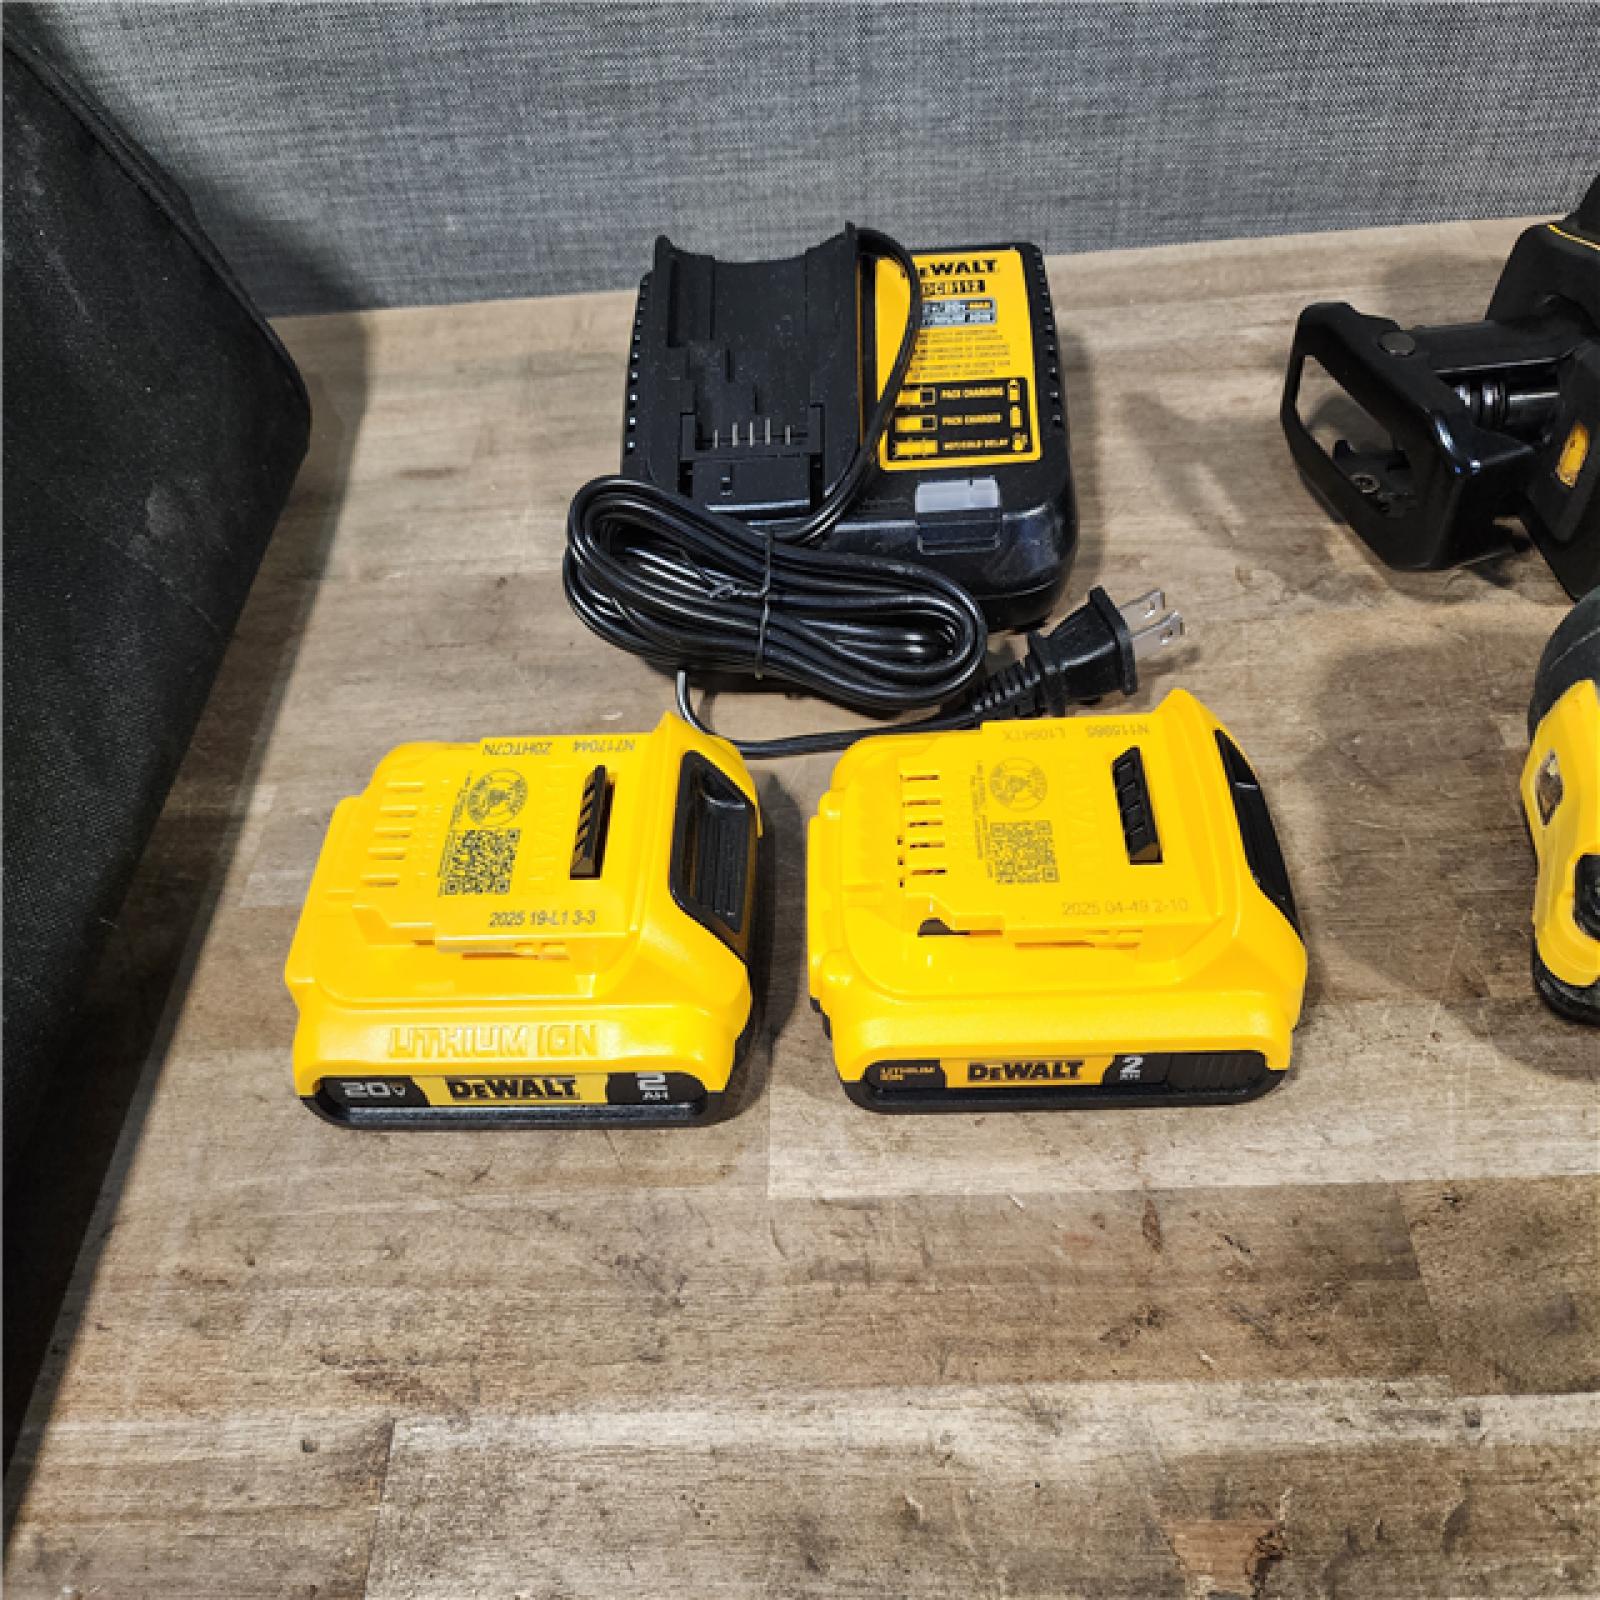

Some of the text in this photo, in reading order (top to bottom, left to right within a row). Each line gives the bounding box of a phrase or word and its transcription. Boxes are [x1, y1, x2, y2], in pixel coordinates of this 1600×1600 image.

[919, 259, 998, 279] EWALT
[1062, 901, 1101, 917] 2025
[489, 911, 526, 928] 2025
[388, 1023, 598, 1059] LITHIUM ION
[967, 1059, 1084, 1081] DEWALT
[1119, 1055, 1144, 1071] 2
[446, 1077, 579, 1100] DEWALT
[636, 1072, 669, 1091] 2
